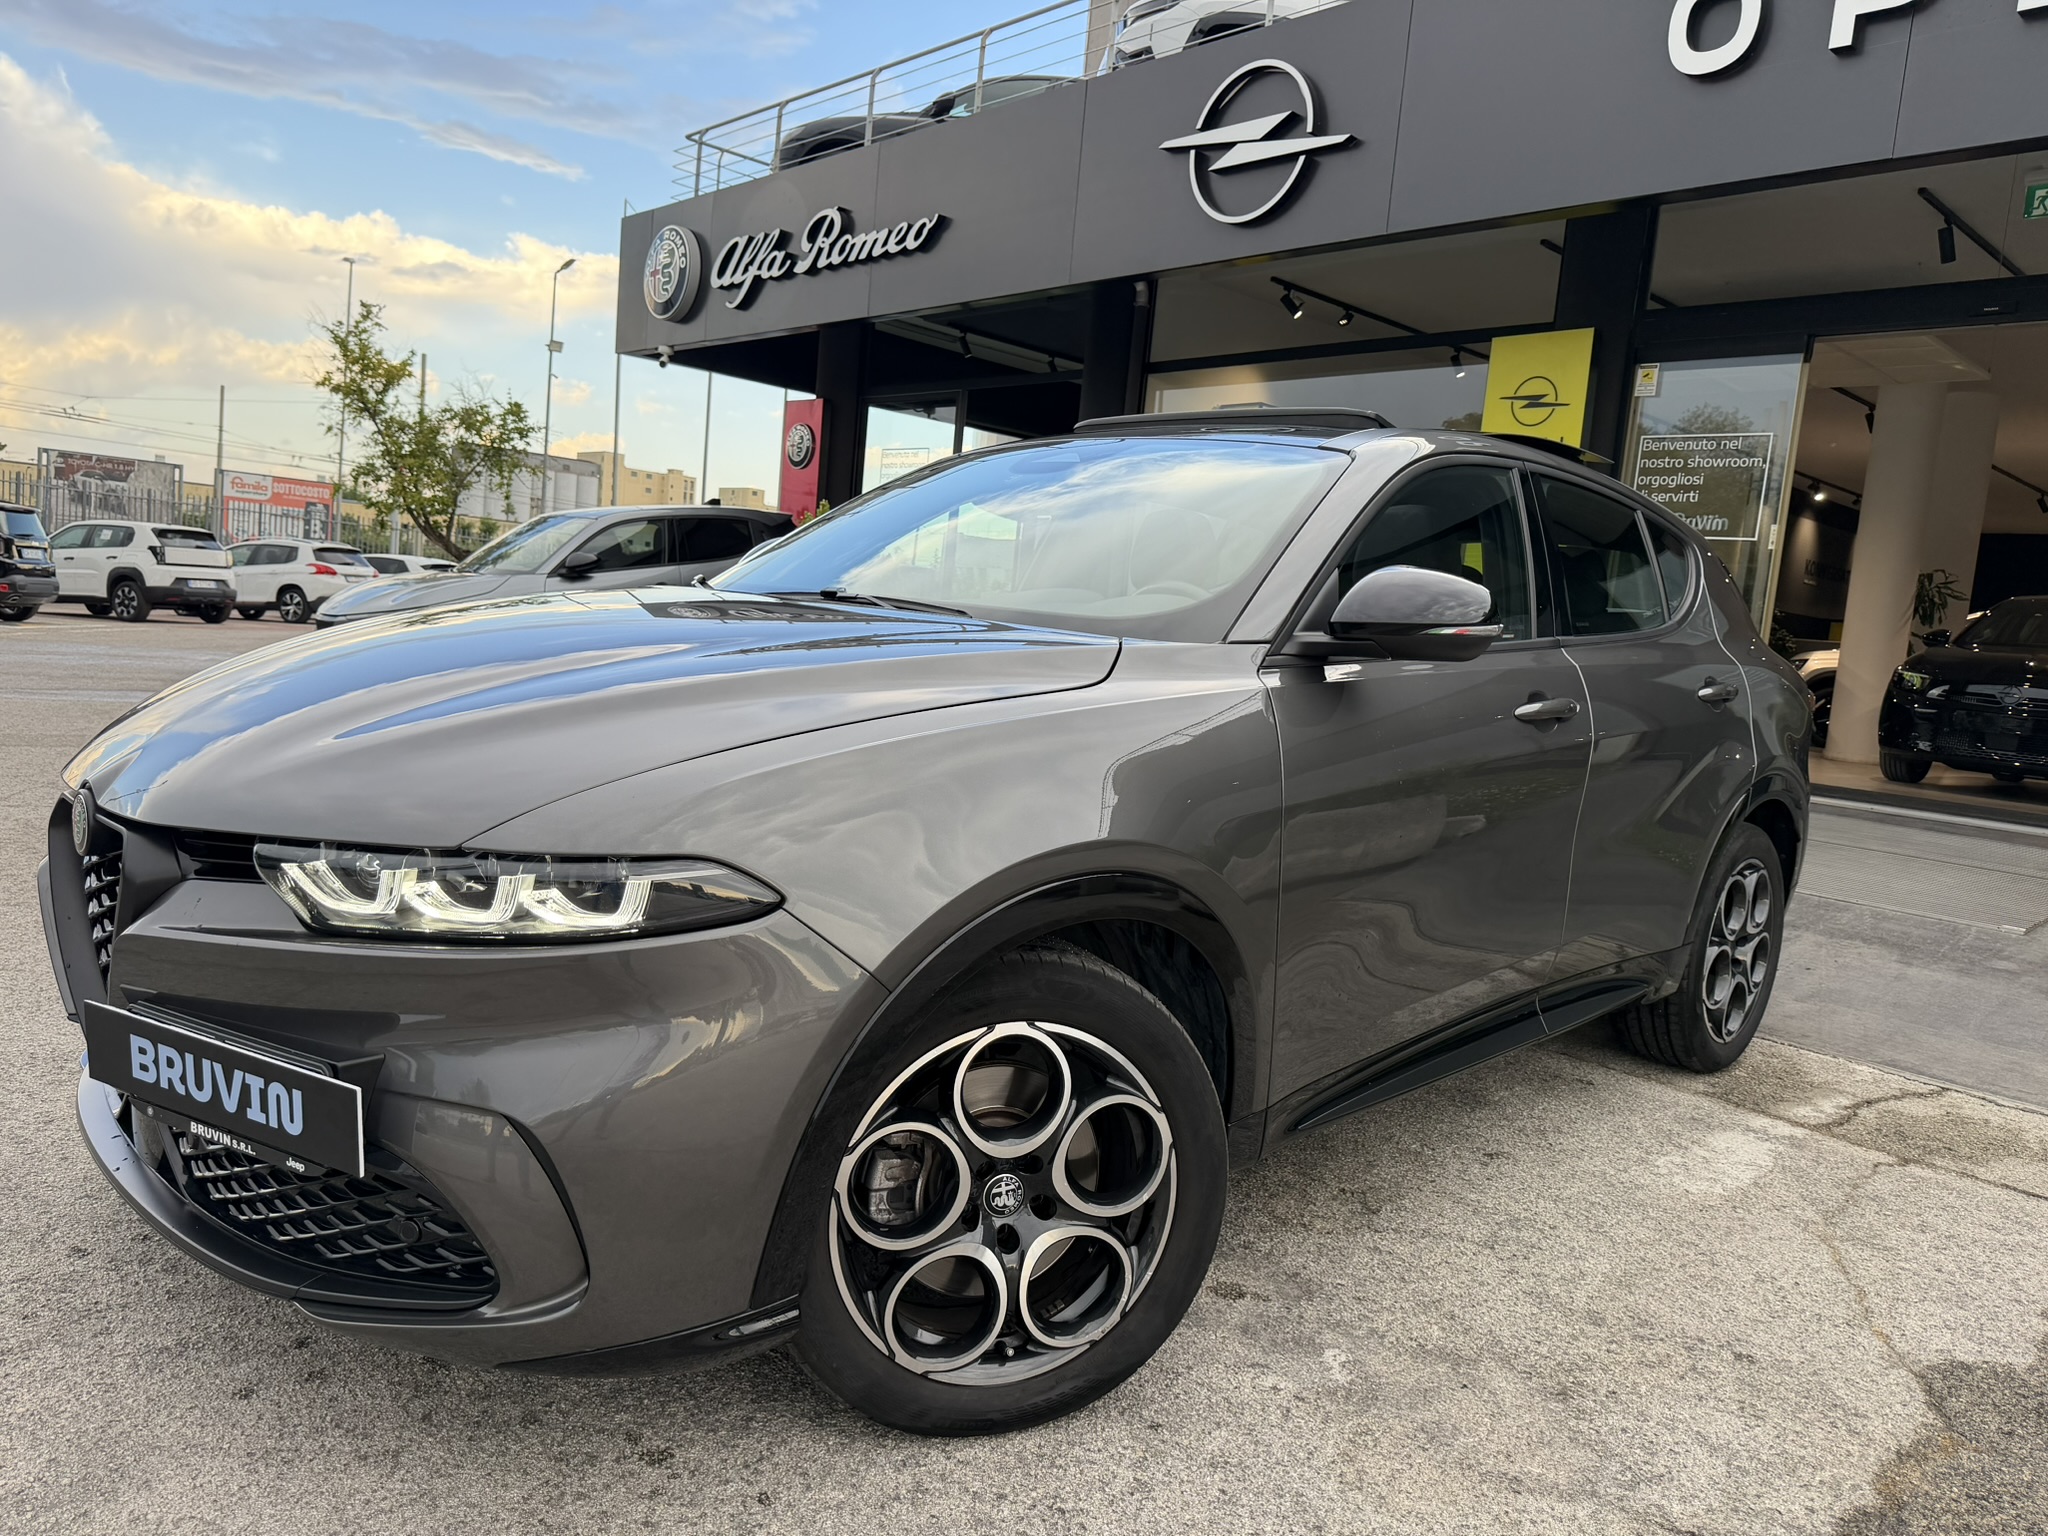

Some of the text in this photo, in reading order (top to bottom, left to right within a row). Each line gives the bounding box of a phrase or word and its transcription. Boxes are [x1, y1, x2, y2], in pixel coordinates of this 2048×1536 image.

[663, 230, 687, 269] ROMEO
[710, 205, 939, 309] Alfa Romeo
[1642, 437, 1743, 451] Benvenuto nel
[1640, 455, 1766, 469] nostro showroom,
[230, 476, 269, 492] famila
[273, 482, 330, 499] SOTTOCOSTO
[1638, 473, 1705, 488] orgogliosi
[1651, 490, 1700, 502] servirti
[130, 1034, 304, 1136] BRUVIN
[190, 1120, 232, 1148] BRUVIN
[286, 1156, 306, 1173] Jeep
